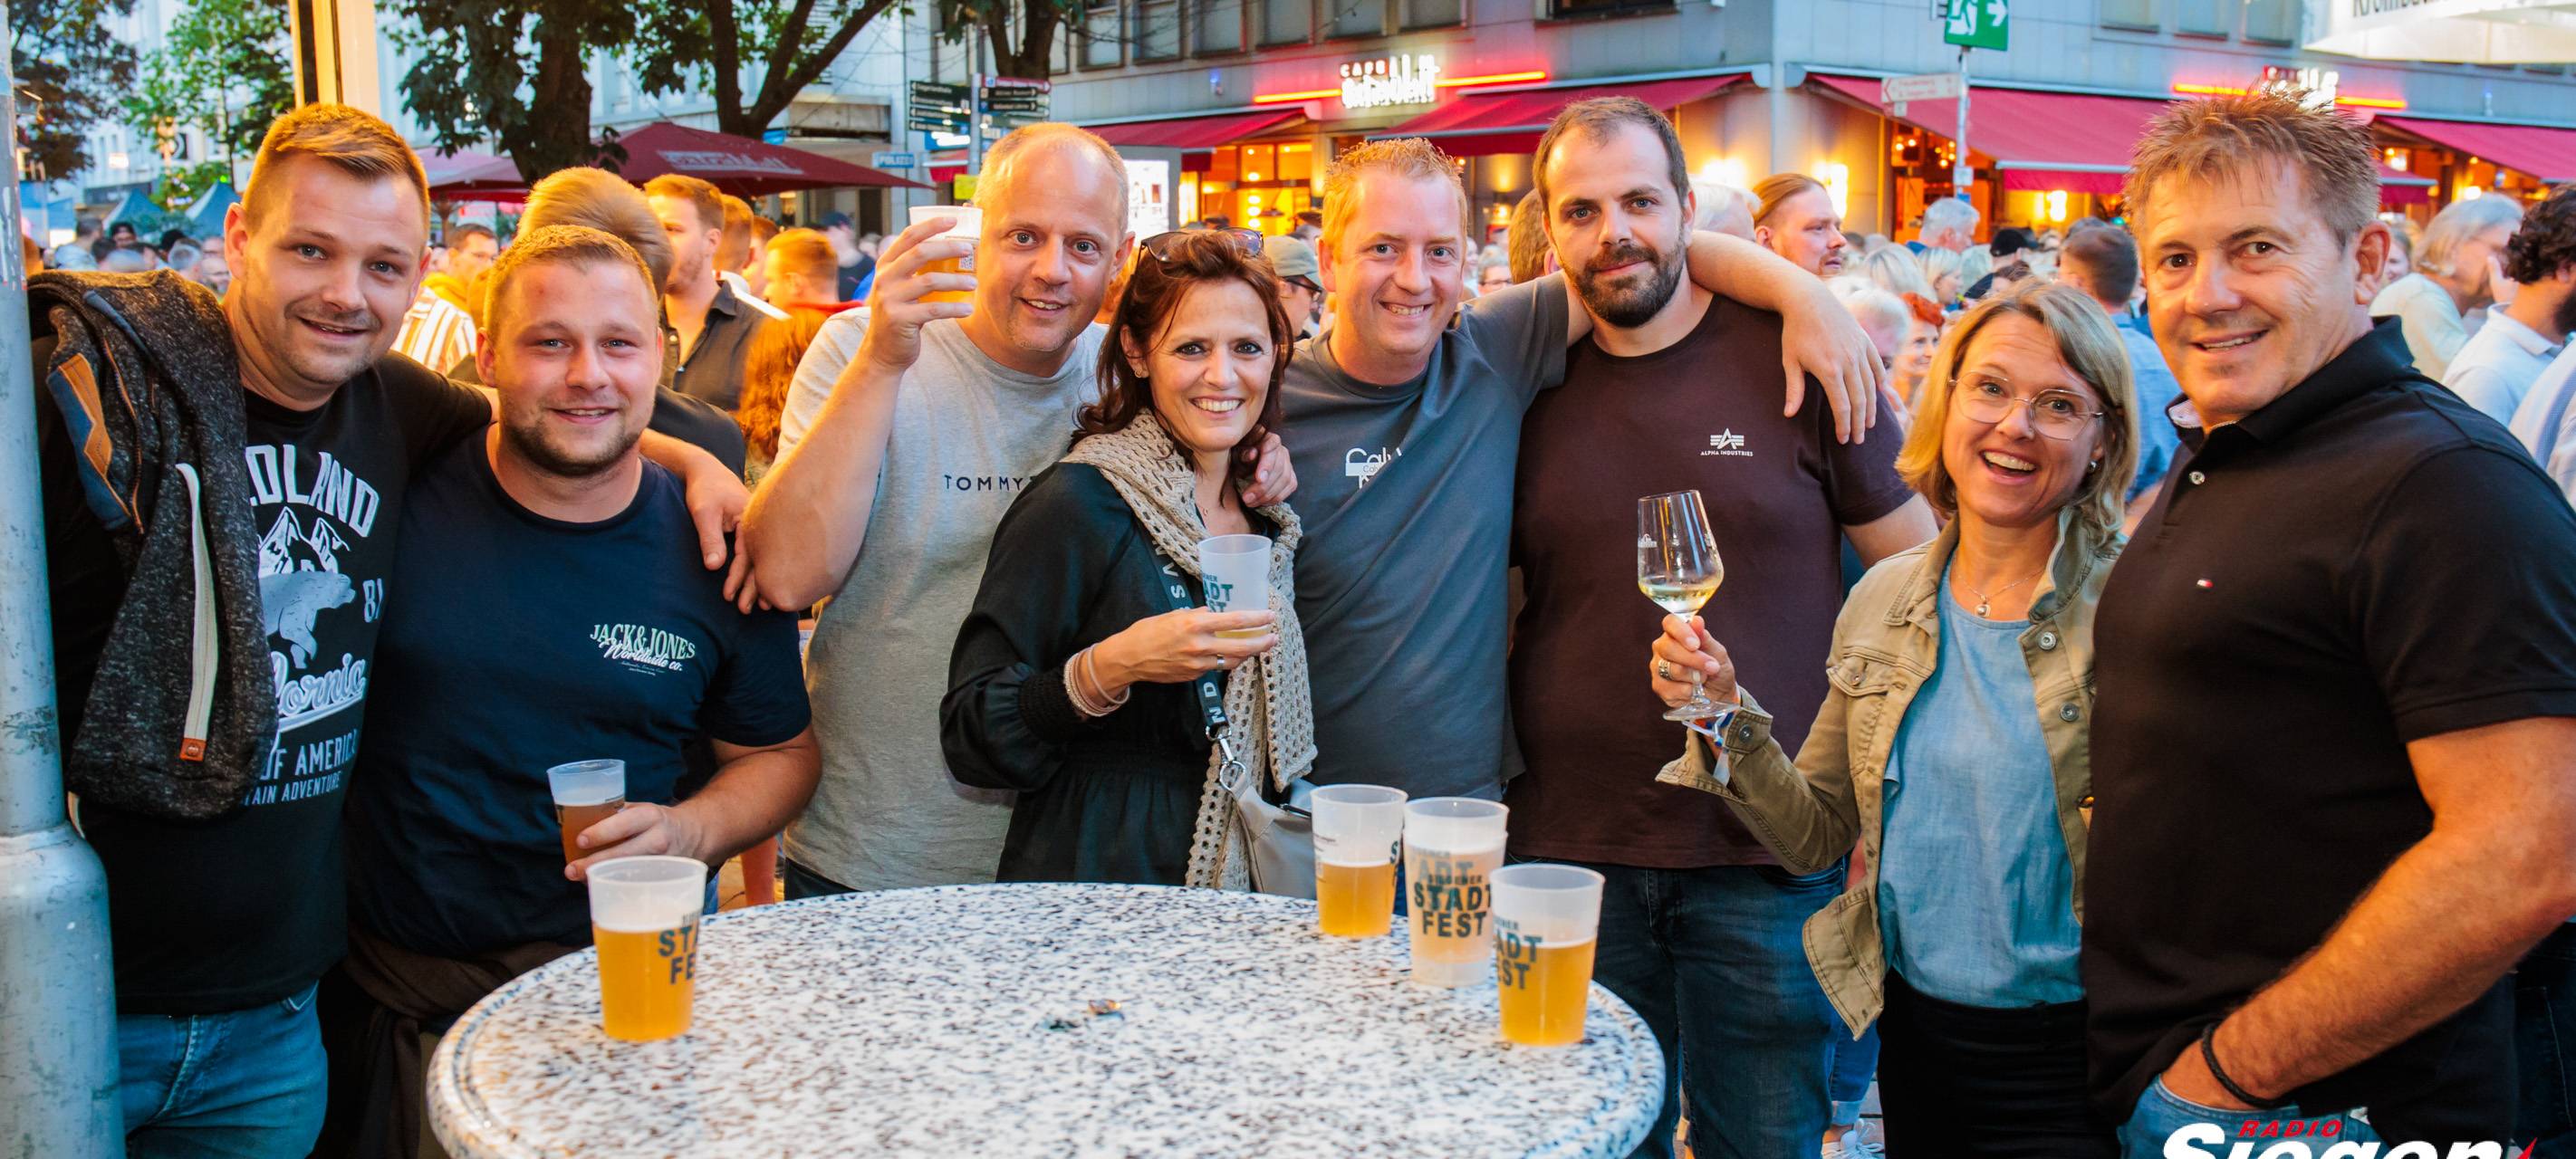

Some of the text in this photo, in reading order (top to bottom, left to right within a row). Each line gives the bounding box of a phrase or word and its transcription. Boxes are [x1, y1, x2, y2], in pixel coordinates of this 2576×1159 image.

[945, 474, 1024, 491] TOMMY
[282, 771, 341, 802] ADVENTURE
[1423, 911, 1487, 938] FEST
